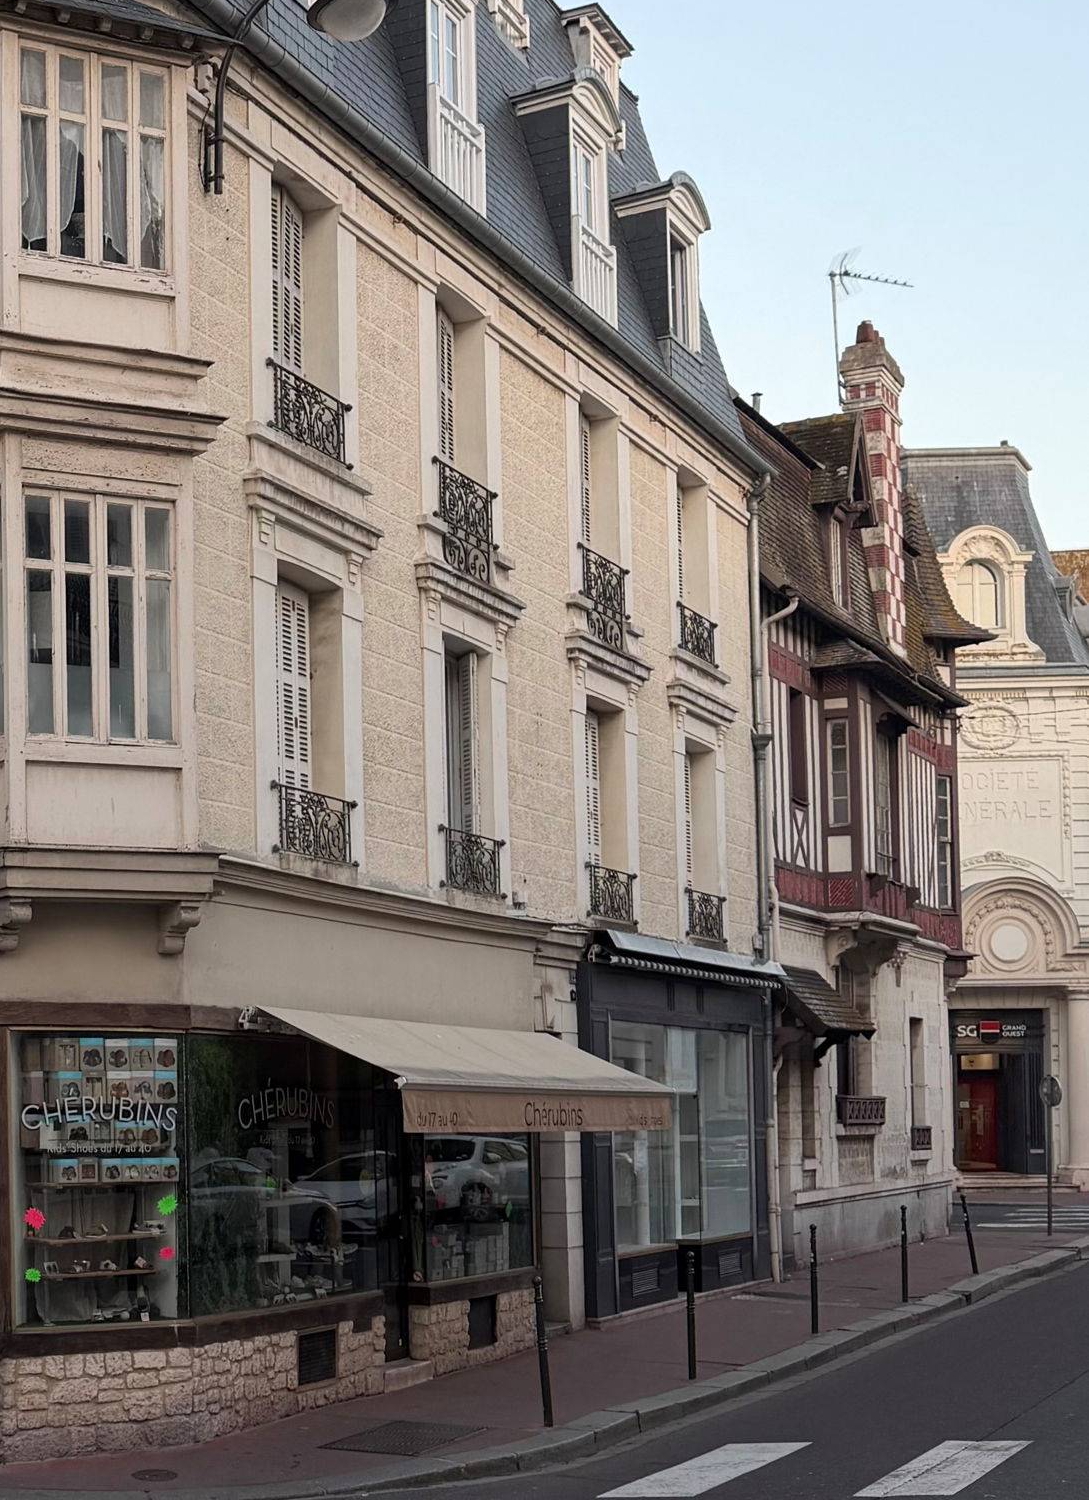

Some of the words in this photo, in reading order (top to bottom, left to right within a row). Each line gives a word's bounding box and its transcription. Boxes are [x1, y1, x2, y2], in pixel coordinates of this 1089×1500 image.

[961, 768, 1039, 791] OCIÉTÉ
[962, 798, 1052, 820] NÉRALE
[957, 1025, 978, 1037] SG
[22, 1087, 178, 1131] CHÉRUBINS
[238, 1077, 335, 1130] CHÉRUBINS
[417, 1112, 427, 1127] du
[428, 1112, 437, 1127] 17
[438, 1115, 448, 1127] au
[524, 1102, 583, 1127] Chérubins
[100, 1142, 112, 1153] du
[124, 1145, 136, 1153] au
[138, 1143, 152, 1154] 40
